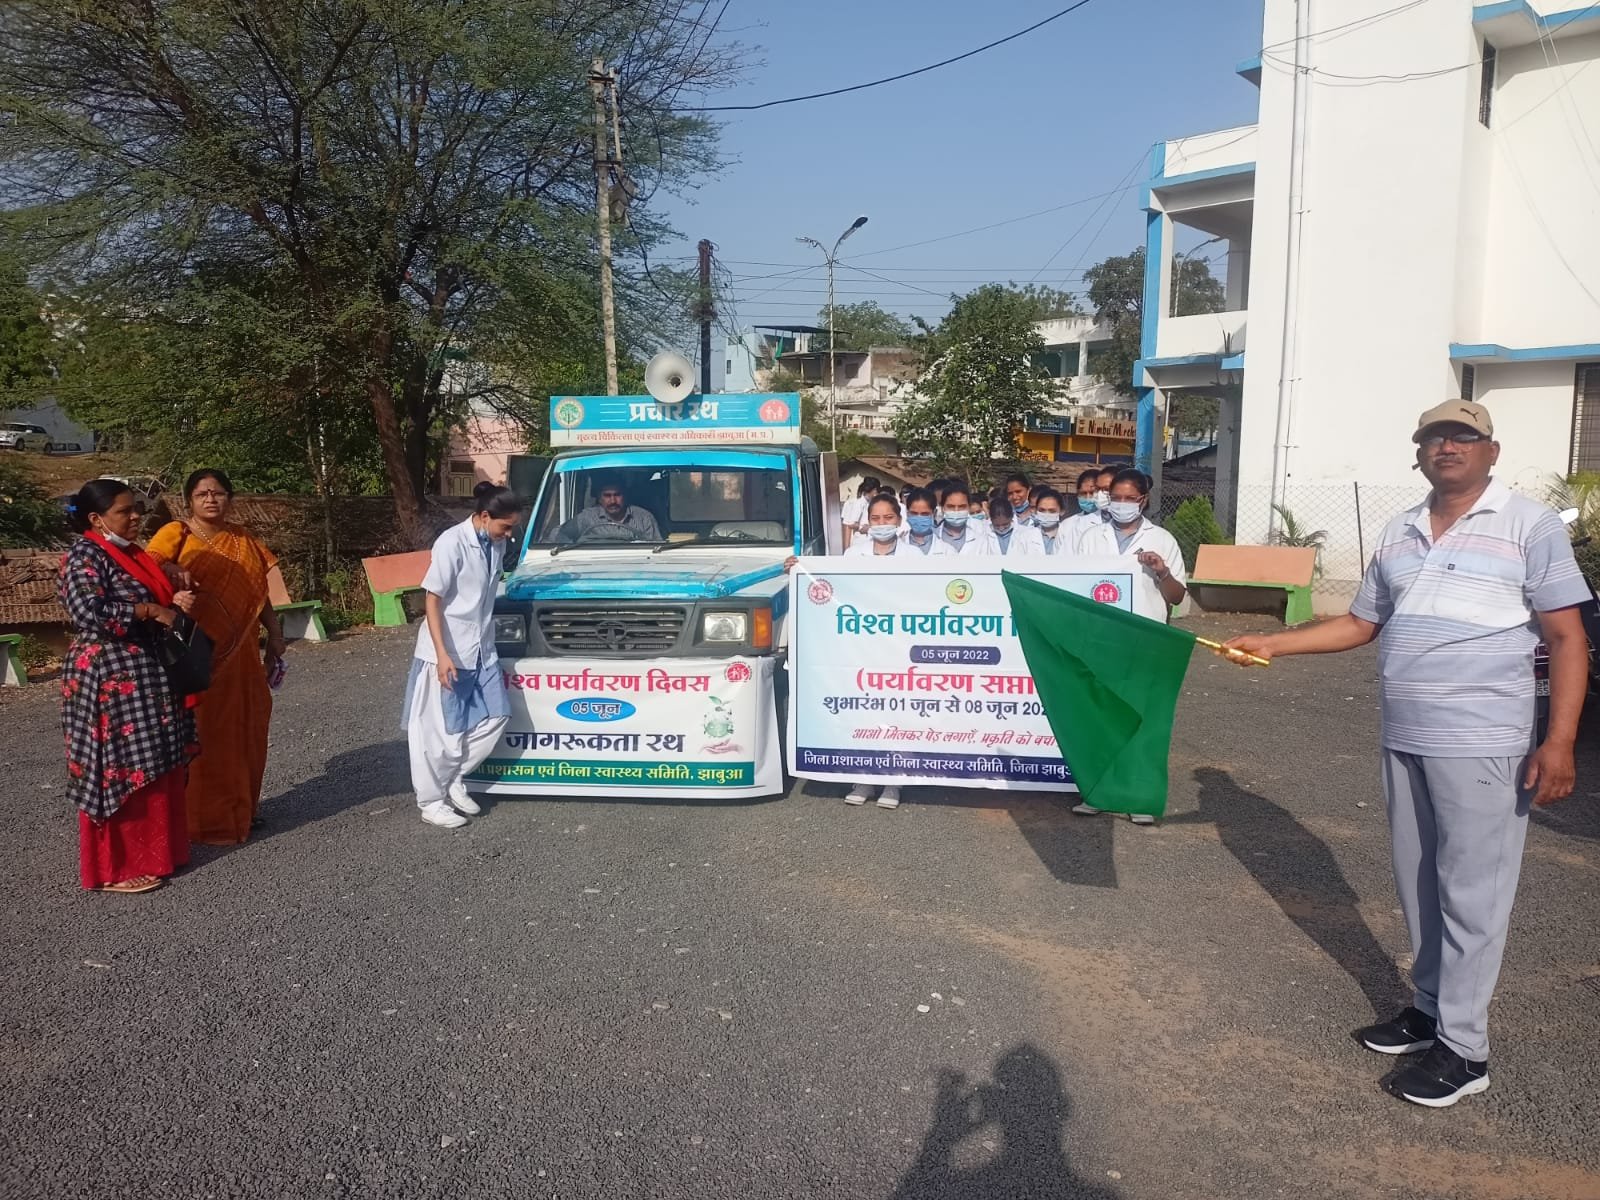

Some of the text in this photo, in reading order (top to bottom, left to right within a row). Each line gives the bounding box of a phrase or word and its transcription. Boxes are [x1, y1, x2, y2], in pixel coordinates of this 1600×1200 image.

[629, 401, 719, 423] प्रचार रथ
[836, 604, 895, 635] विश्व
[900, 606, 1004, 637] पर्यावरण
[921, 651, 989, 663] 05 जून 2022
[546, 668, 641, 691] पर्यावरण
[646, 668, 711, 693] दिवस
[980, 674, 1034, 695] सप्ता
[571, 702, 621, 719] 05 जून
[823, 692, 885, 714] शुभारंभ
[889, 700, 906, 711] 01
[910, 699, 941, 717] जून
[945, 695, 961, 713] से
[964, 702, 983, 714] 08
[986, 701, 1018, 720] जून
[505, 732, 685, 752] जागरूकता रथ
[1015, 731, 1033, 745] को
[537, 762, 555, 777] एवं
[558, 762, 591, 777] जिला
[594, 766, 642, 778] स्वास्थ्य
[697, 768, 743, 784] झाबुआ
[804, 751, 831, 765] जिला
[831, 755, 873, 768] प्रशासन
[875, 753, 890, 769] एवं
[892, 754, 920, 770] जिला
[922, 759, 964, 771] स्वास्थ्य
[1010, 759, 1040, 775] जिला
